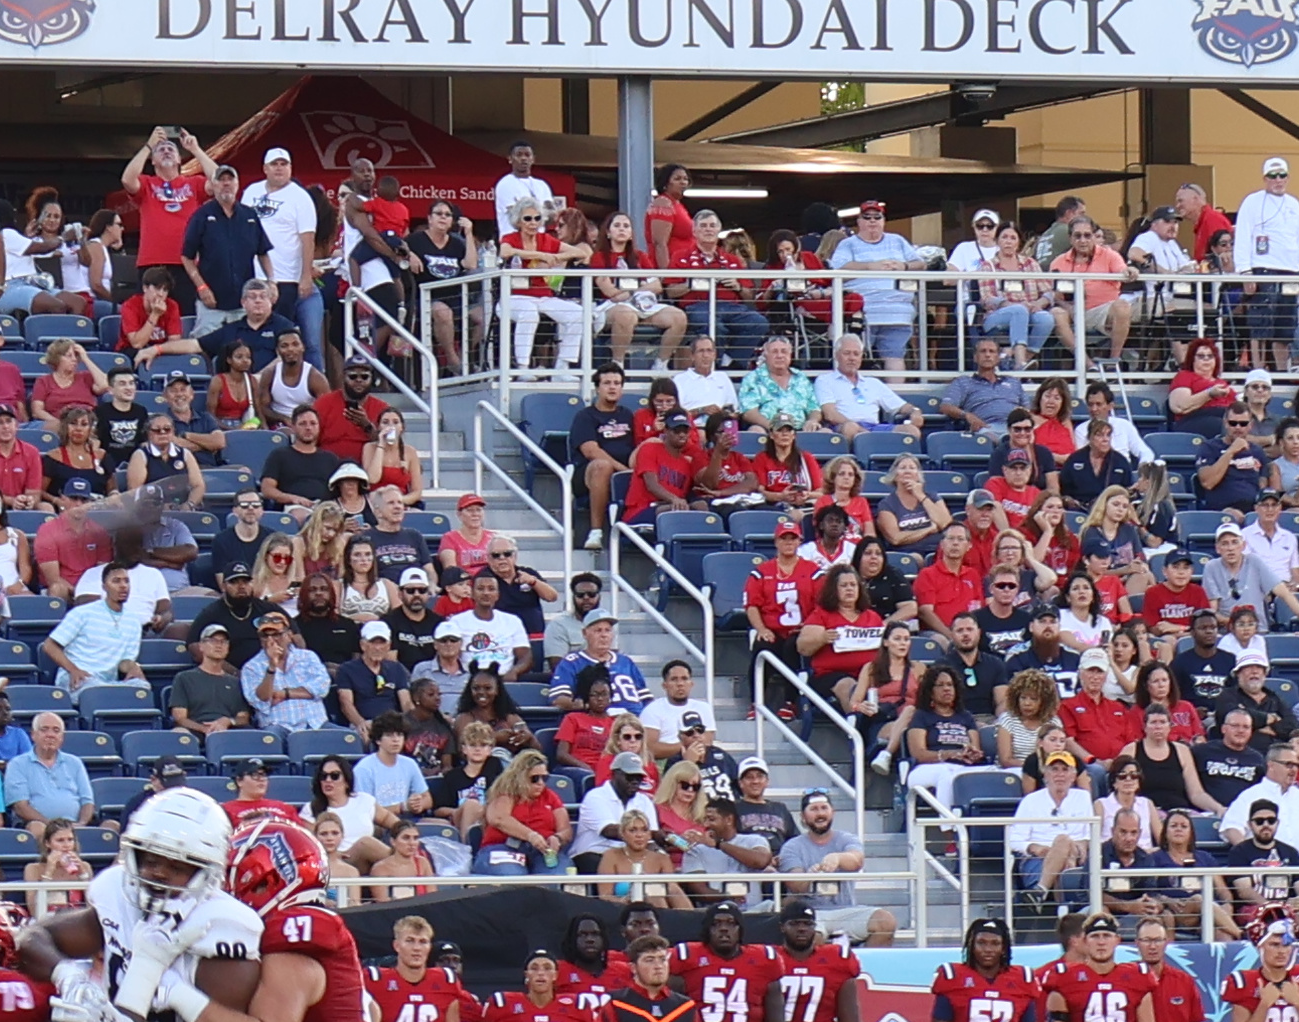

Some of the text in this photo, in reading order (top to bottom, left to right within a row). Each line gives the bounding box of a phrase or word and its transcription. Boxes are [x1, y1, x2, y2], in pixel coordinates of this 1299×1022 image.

[155, 0, 1135, 54] DELRAY HYUNDAI DECK
[399, 185, 457, 199] Chicken
[776, 590, 803, 627] 3
[1193, 674, 1229, 687] FAU
[270, 838, 297, 881] ATLANTIC
[283, 915, 313, 943] 47
[780, 976, 825, 1022] 77
